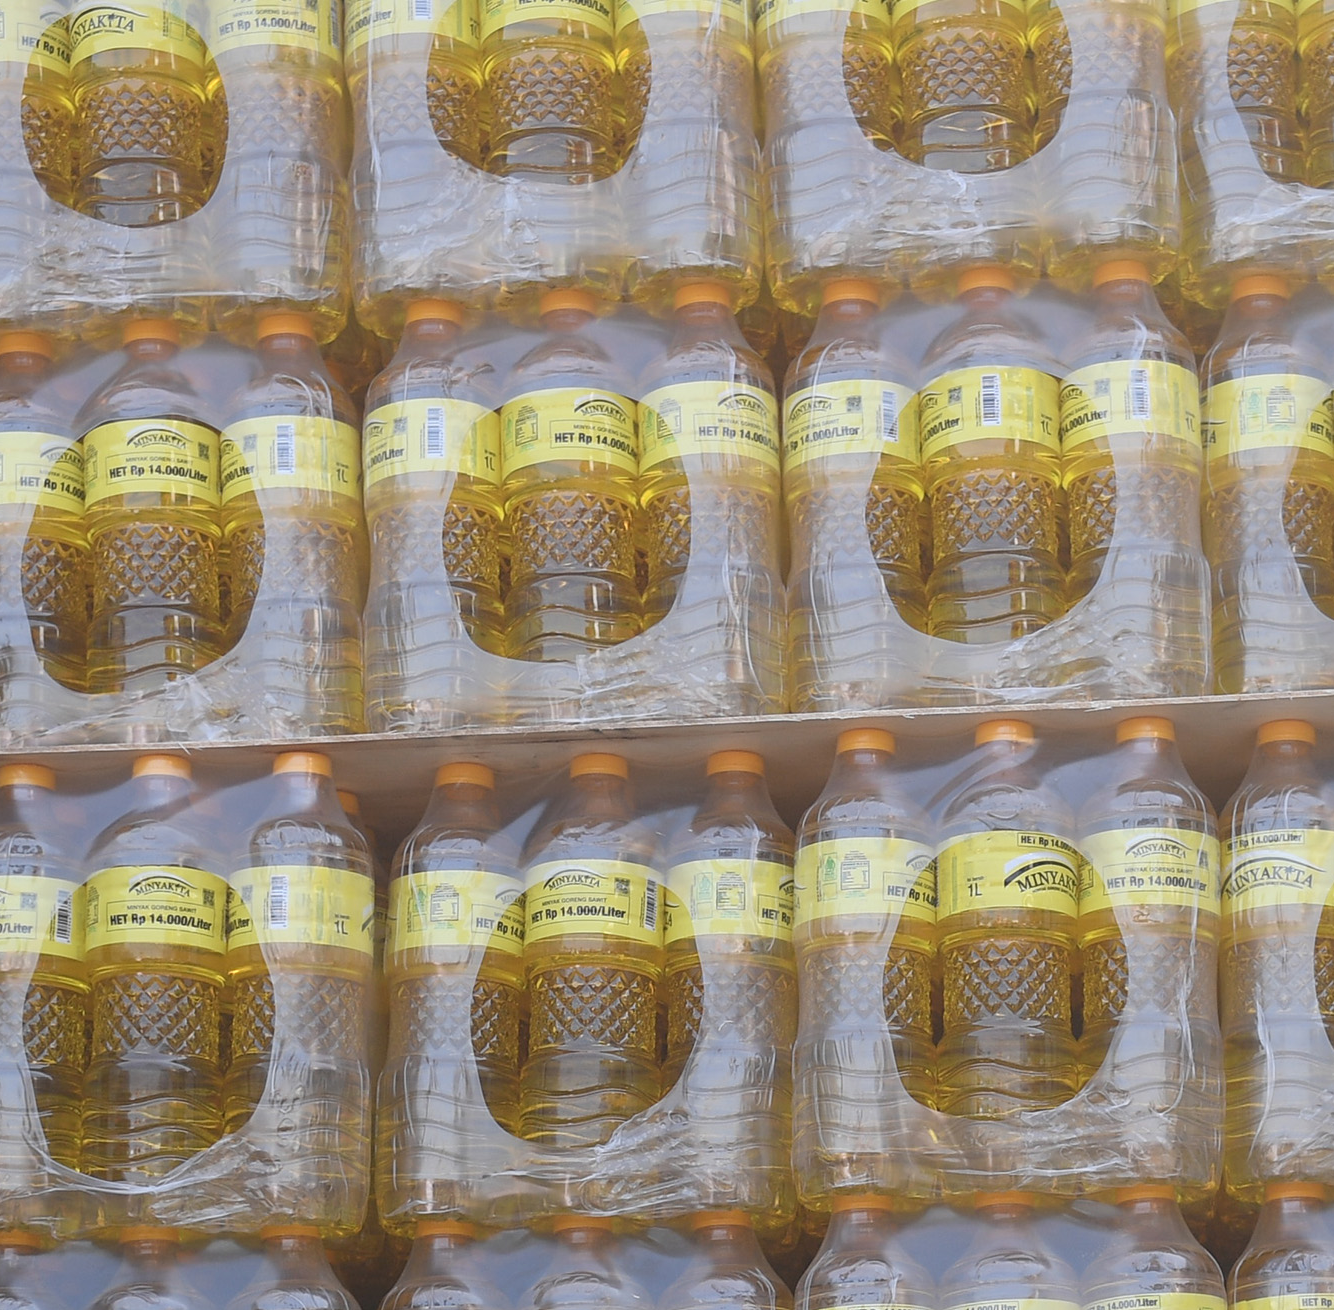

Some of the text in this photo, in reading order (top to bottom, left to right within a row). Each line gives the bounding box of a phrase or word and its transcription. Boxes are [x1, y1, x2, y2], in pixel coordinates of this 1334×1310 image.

[133, 435, 186, 450] MINYAKITA
[555, 431, 592, 446] HET Rp
[109, 464, 208, 484] HET Rp 14.000/Liter
[1251, 831, 1302, 846] 14.000/Liter
[136, 882, 190, 898] MINYAKITA
[548, 875, 601, 891] MINYAKITA
[1107, 875, 1144, 889] HET Rp
[1224, 868, 1313, 900] MINYAKITA
[546, 904, 626, 921] Rp 14.000/Liter
[110, 913, 211, 932] HET Rp 14.000/Liter
